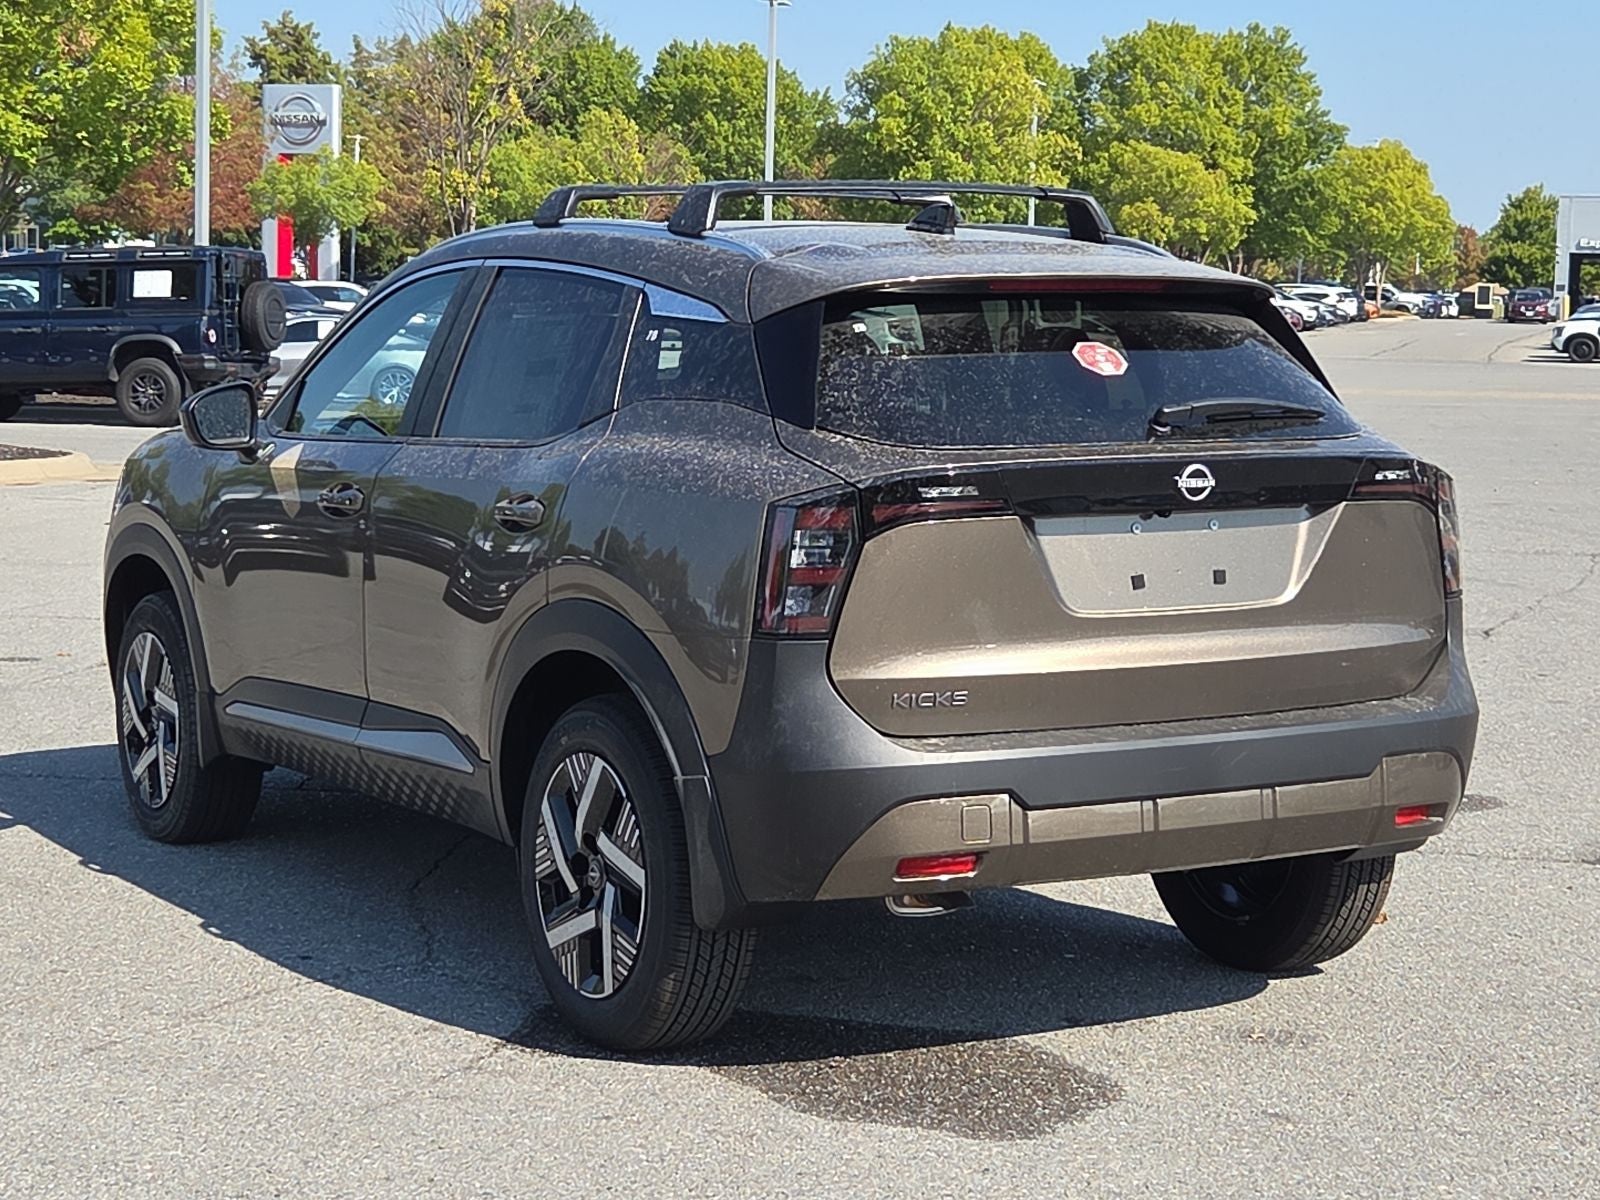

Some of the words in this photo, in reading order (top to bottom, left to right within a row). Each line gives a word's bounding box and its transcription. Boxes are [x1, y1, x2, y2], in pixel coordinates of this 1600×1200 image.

[273, 114, 320, 125] NISSAN
[1178, 478, 1215, 488] NISSAN
[891, 690, 969, 709] KICKS
